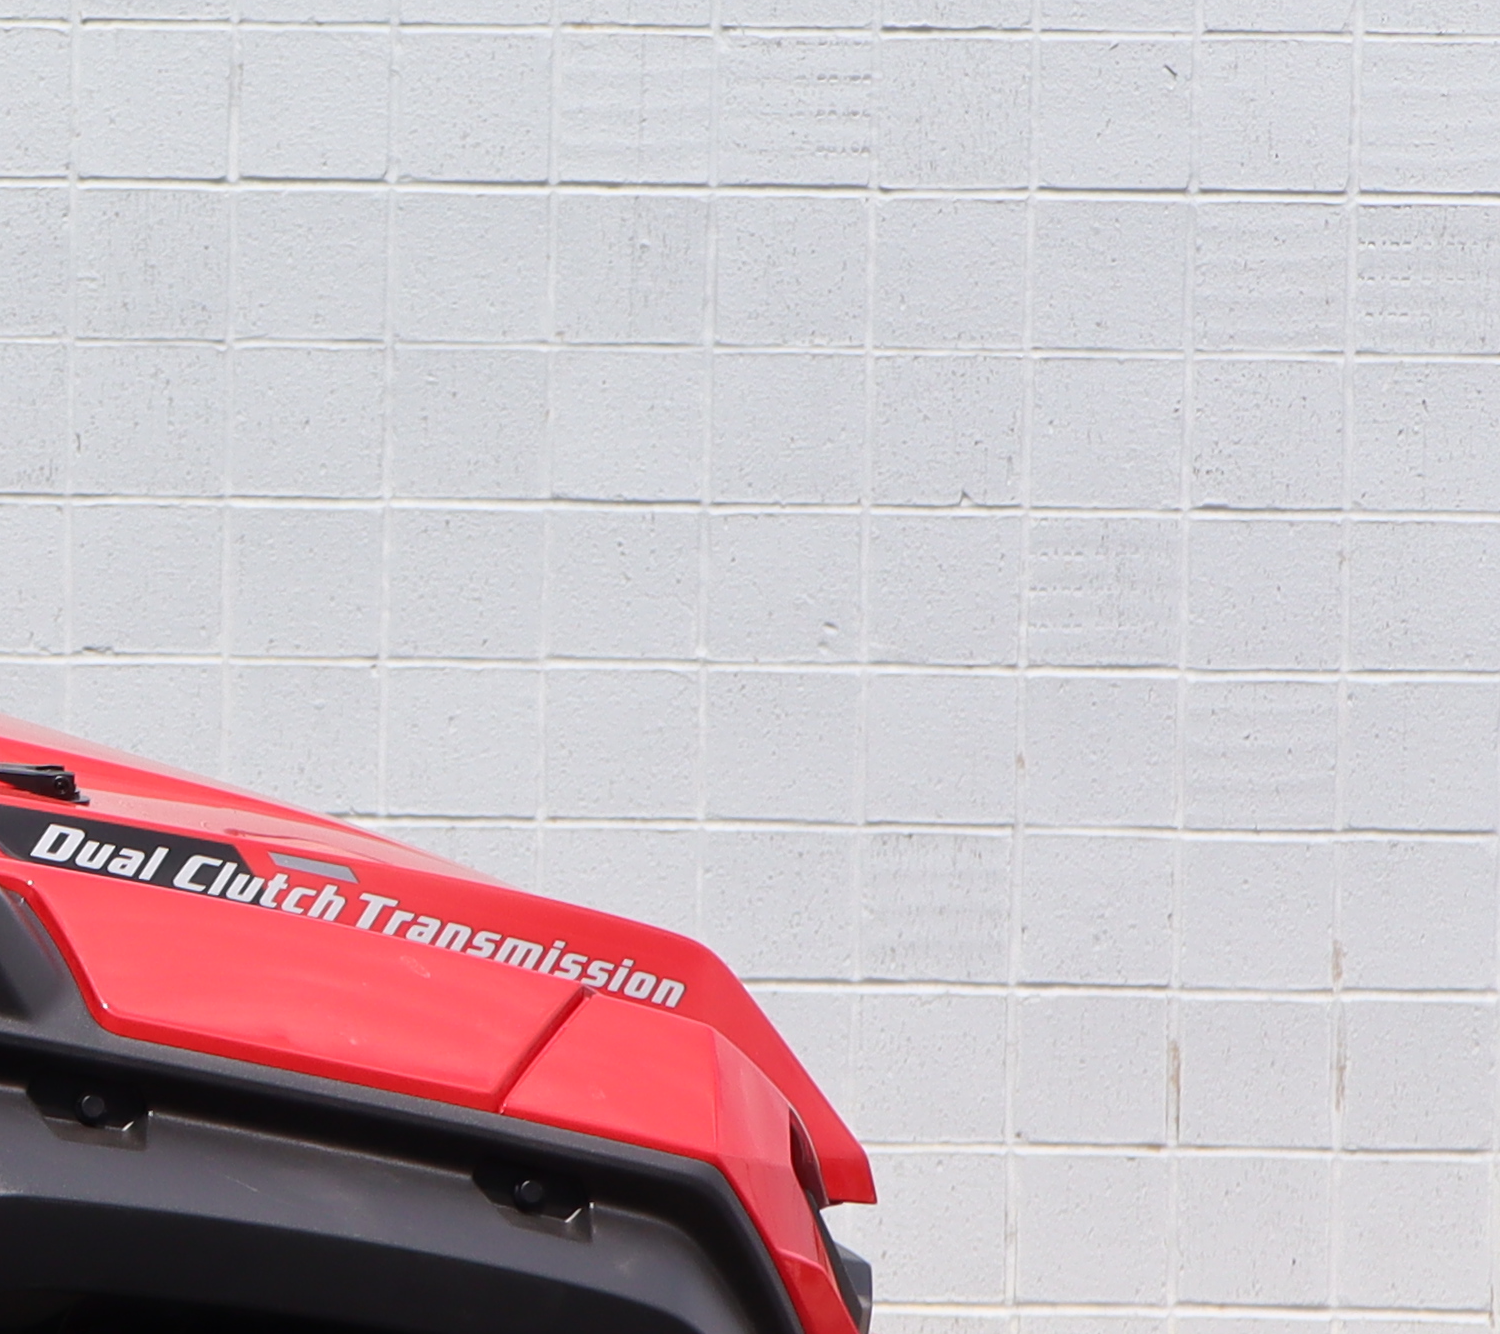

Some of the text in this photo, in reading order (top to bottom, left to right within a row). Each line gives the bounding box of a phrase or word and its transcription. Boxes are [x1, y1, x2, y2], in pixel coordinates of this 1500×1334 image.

[30, 823, 687, 1008] Dual Clutch Transmission
